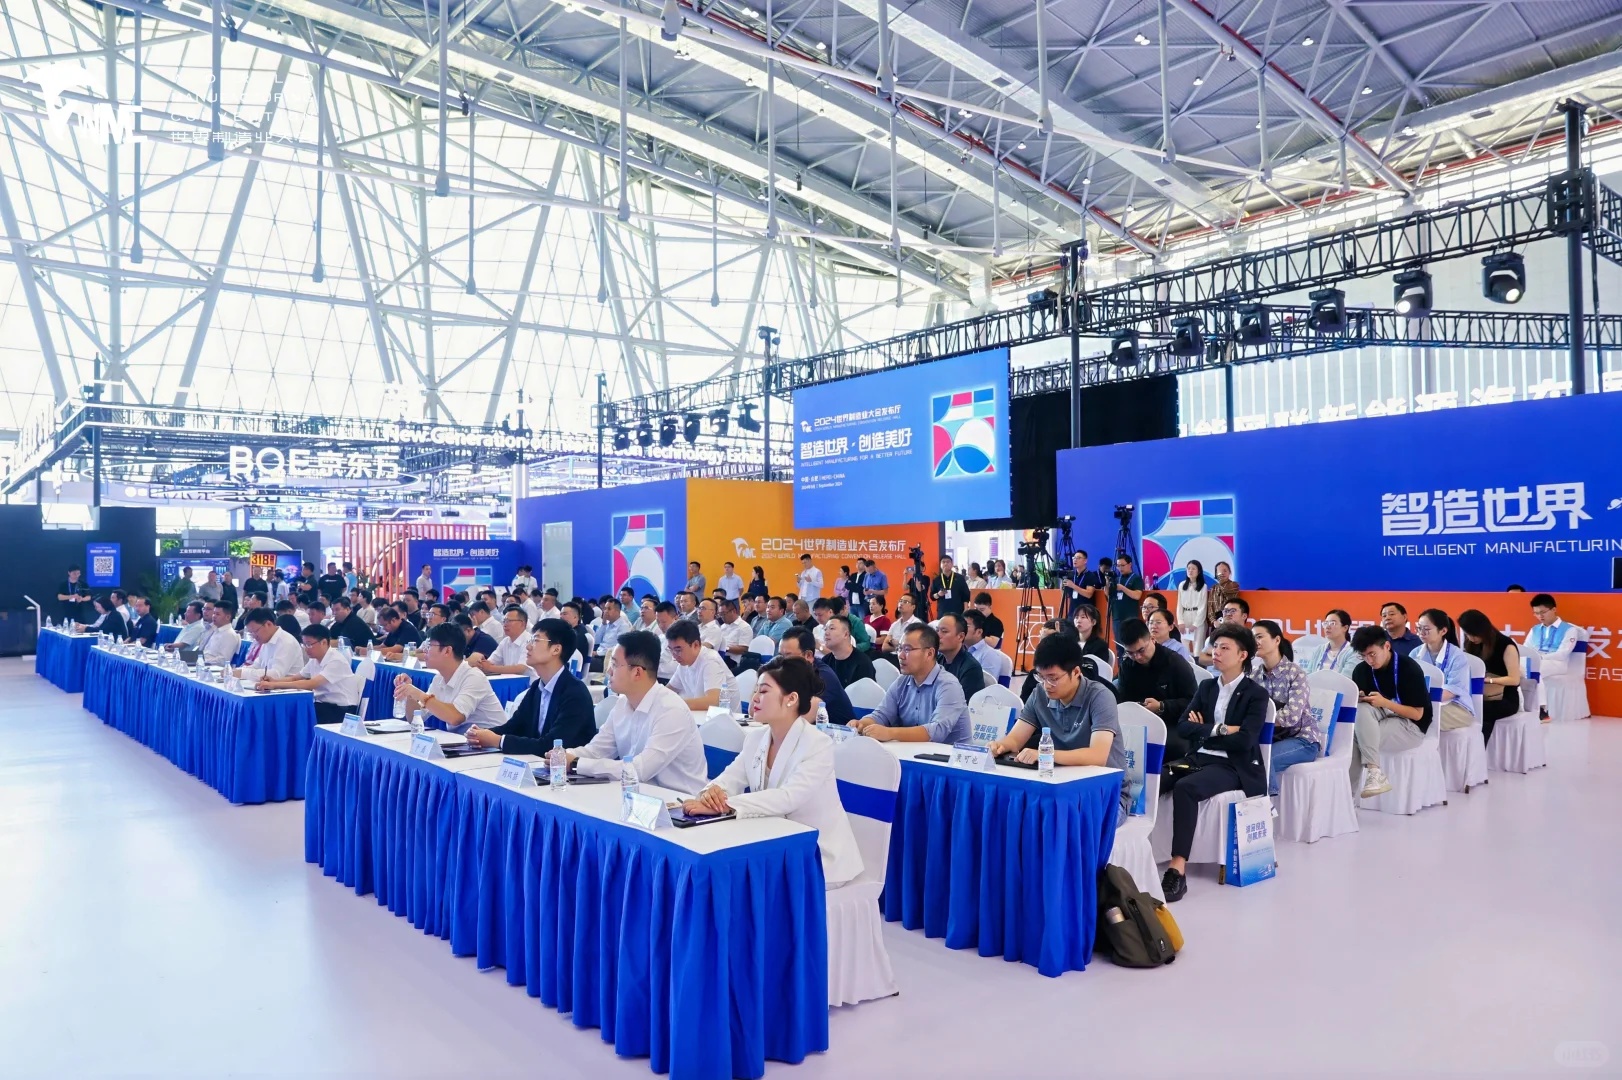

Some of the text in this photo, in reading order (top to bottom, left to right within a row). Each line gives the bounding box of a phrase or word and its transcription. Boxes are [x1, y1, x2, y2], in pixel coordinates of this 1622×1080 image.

[814, 404, 901, 427] 2024世界制造业大会发布厅
[1381, 482, 1593, 537] 智造世界
[761, 537, 906, 552] 2024世界制造业大会发布厅
[1383, 543, 1477, 557] INTELLIGENT
